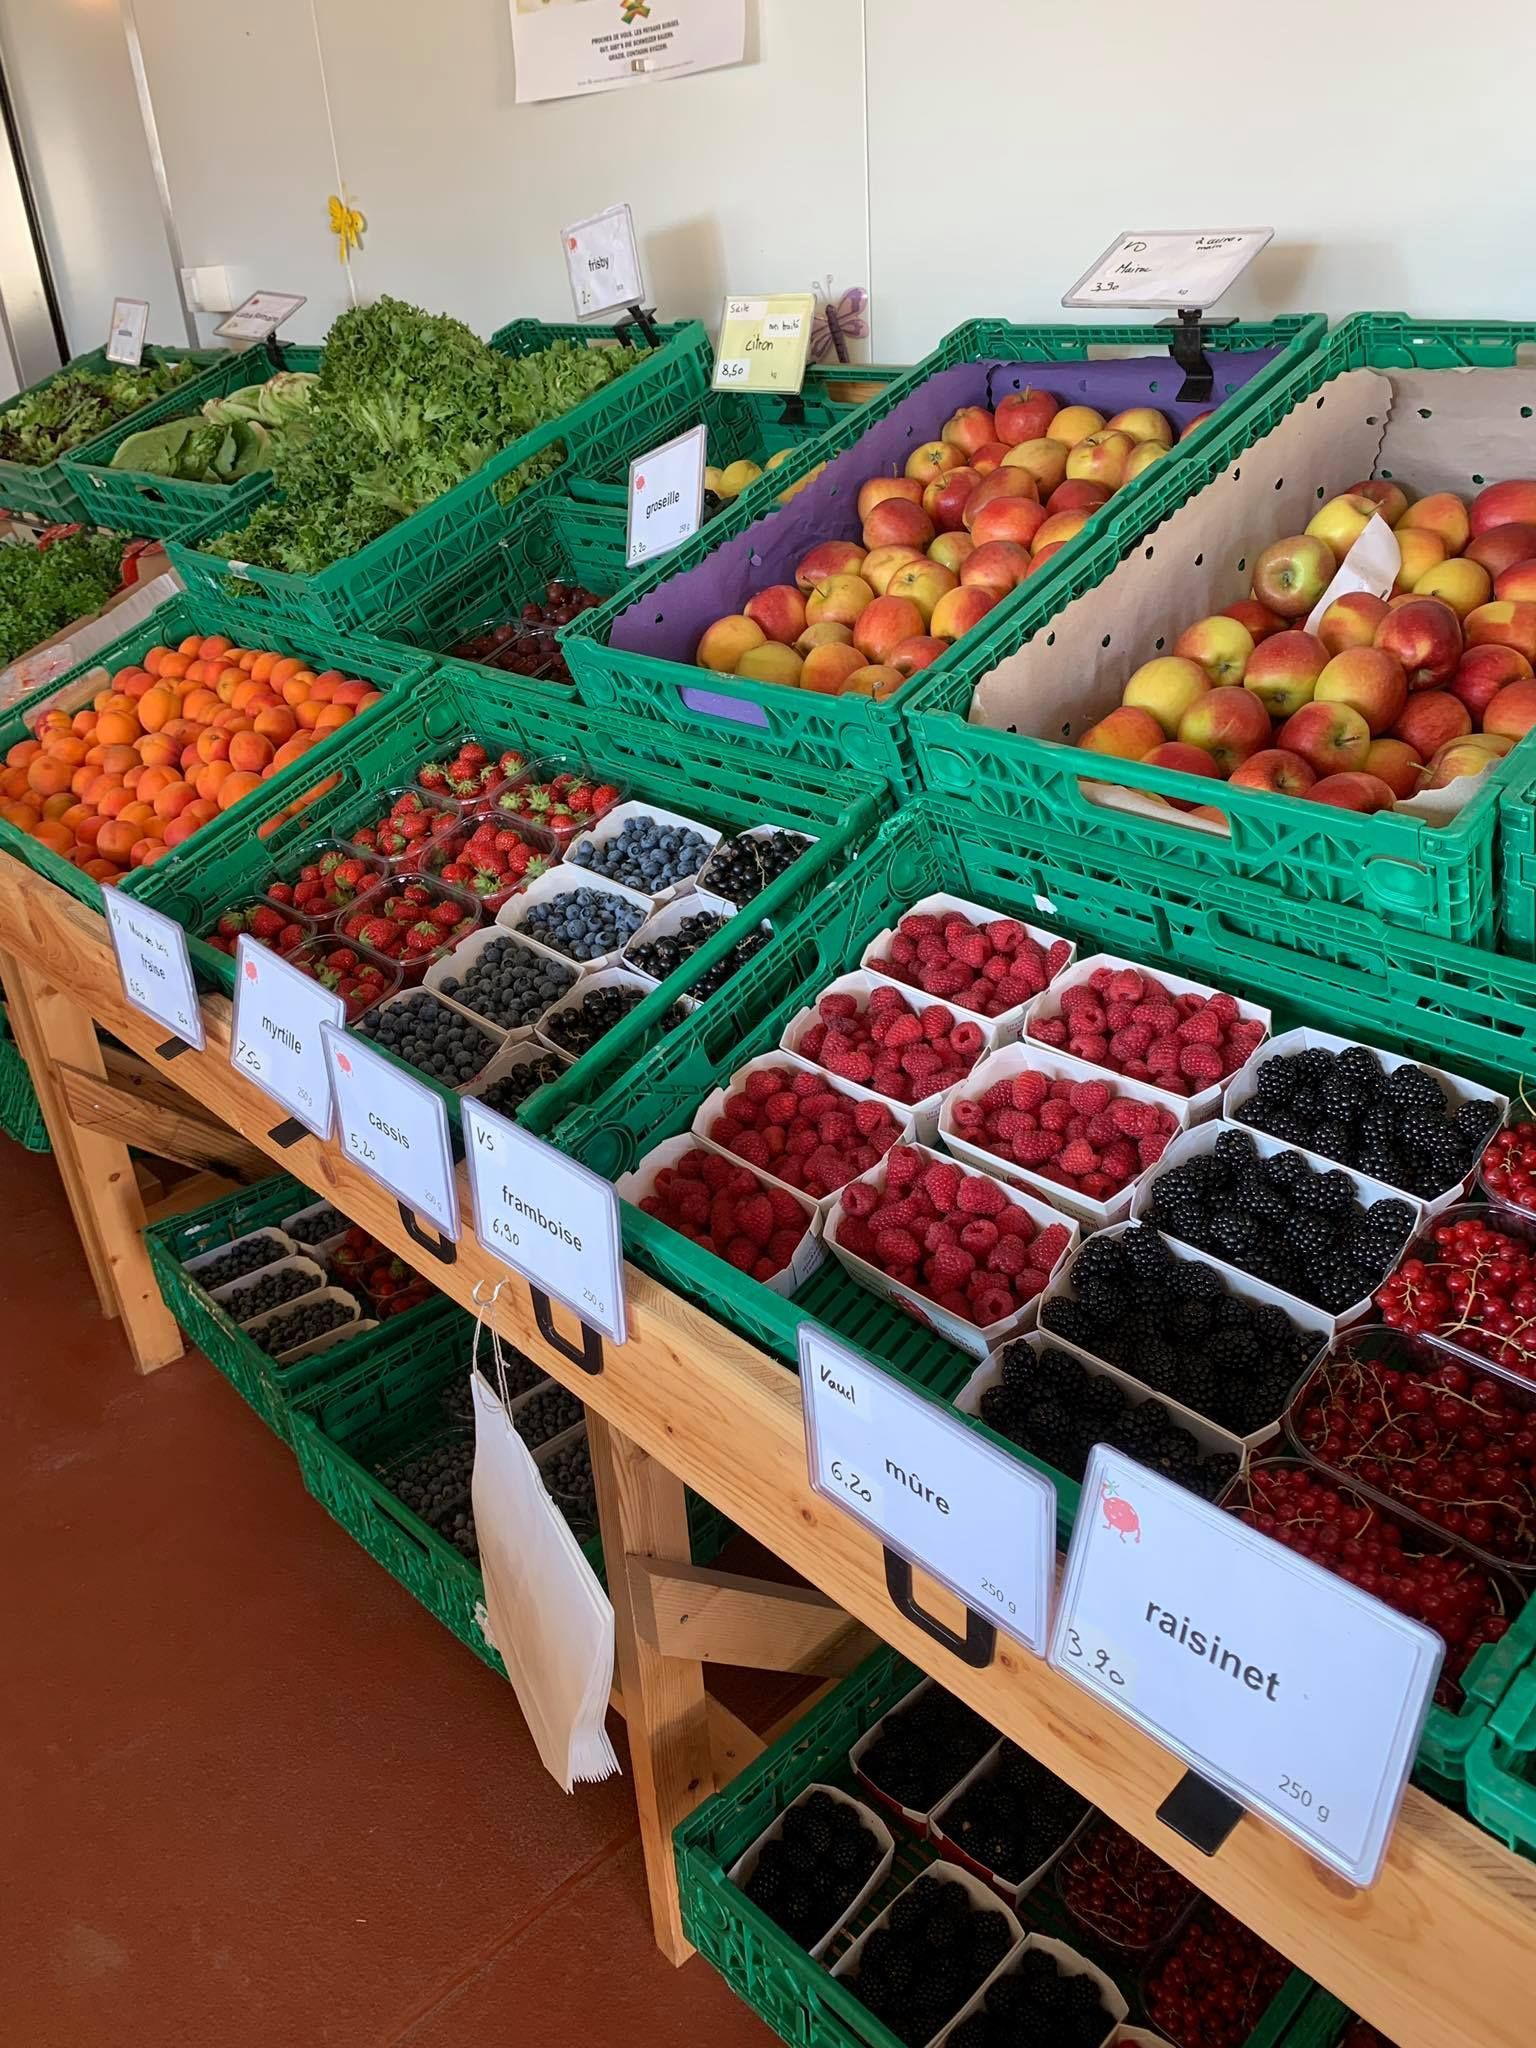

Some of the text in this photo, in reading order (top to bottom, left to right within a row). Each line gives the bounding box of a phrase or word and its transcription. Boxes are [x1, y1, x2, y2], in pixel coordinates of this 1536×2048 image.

[588, 256, 609, 272] frisby
[745, 333, 774, 352] citron
[645, 489, 680, 519] groseille
[140, 953, 167, 980] fraise
[261, 1015, 302, 1054] myrtille
[368, 1112, 410, 1149] cassis
[476, 1126, 494, 1151] VS
[502, 1185, 583, 1252] framboise
[583, 1288, 605, 1313] 250 g
[820, 1364, 857, 1405] Vaud
[831, 1461, 873, 1503] 6.20
[885, 1457, 950, 1515] mûre
[980, 1577, 1016, 1614] 250 g
[1145, 1601, 1281, 1703] raisinet
[1278, 1774, 1331, 1823] 250 g
